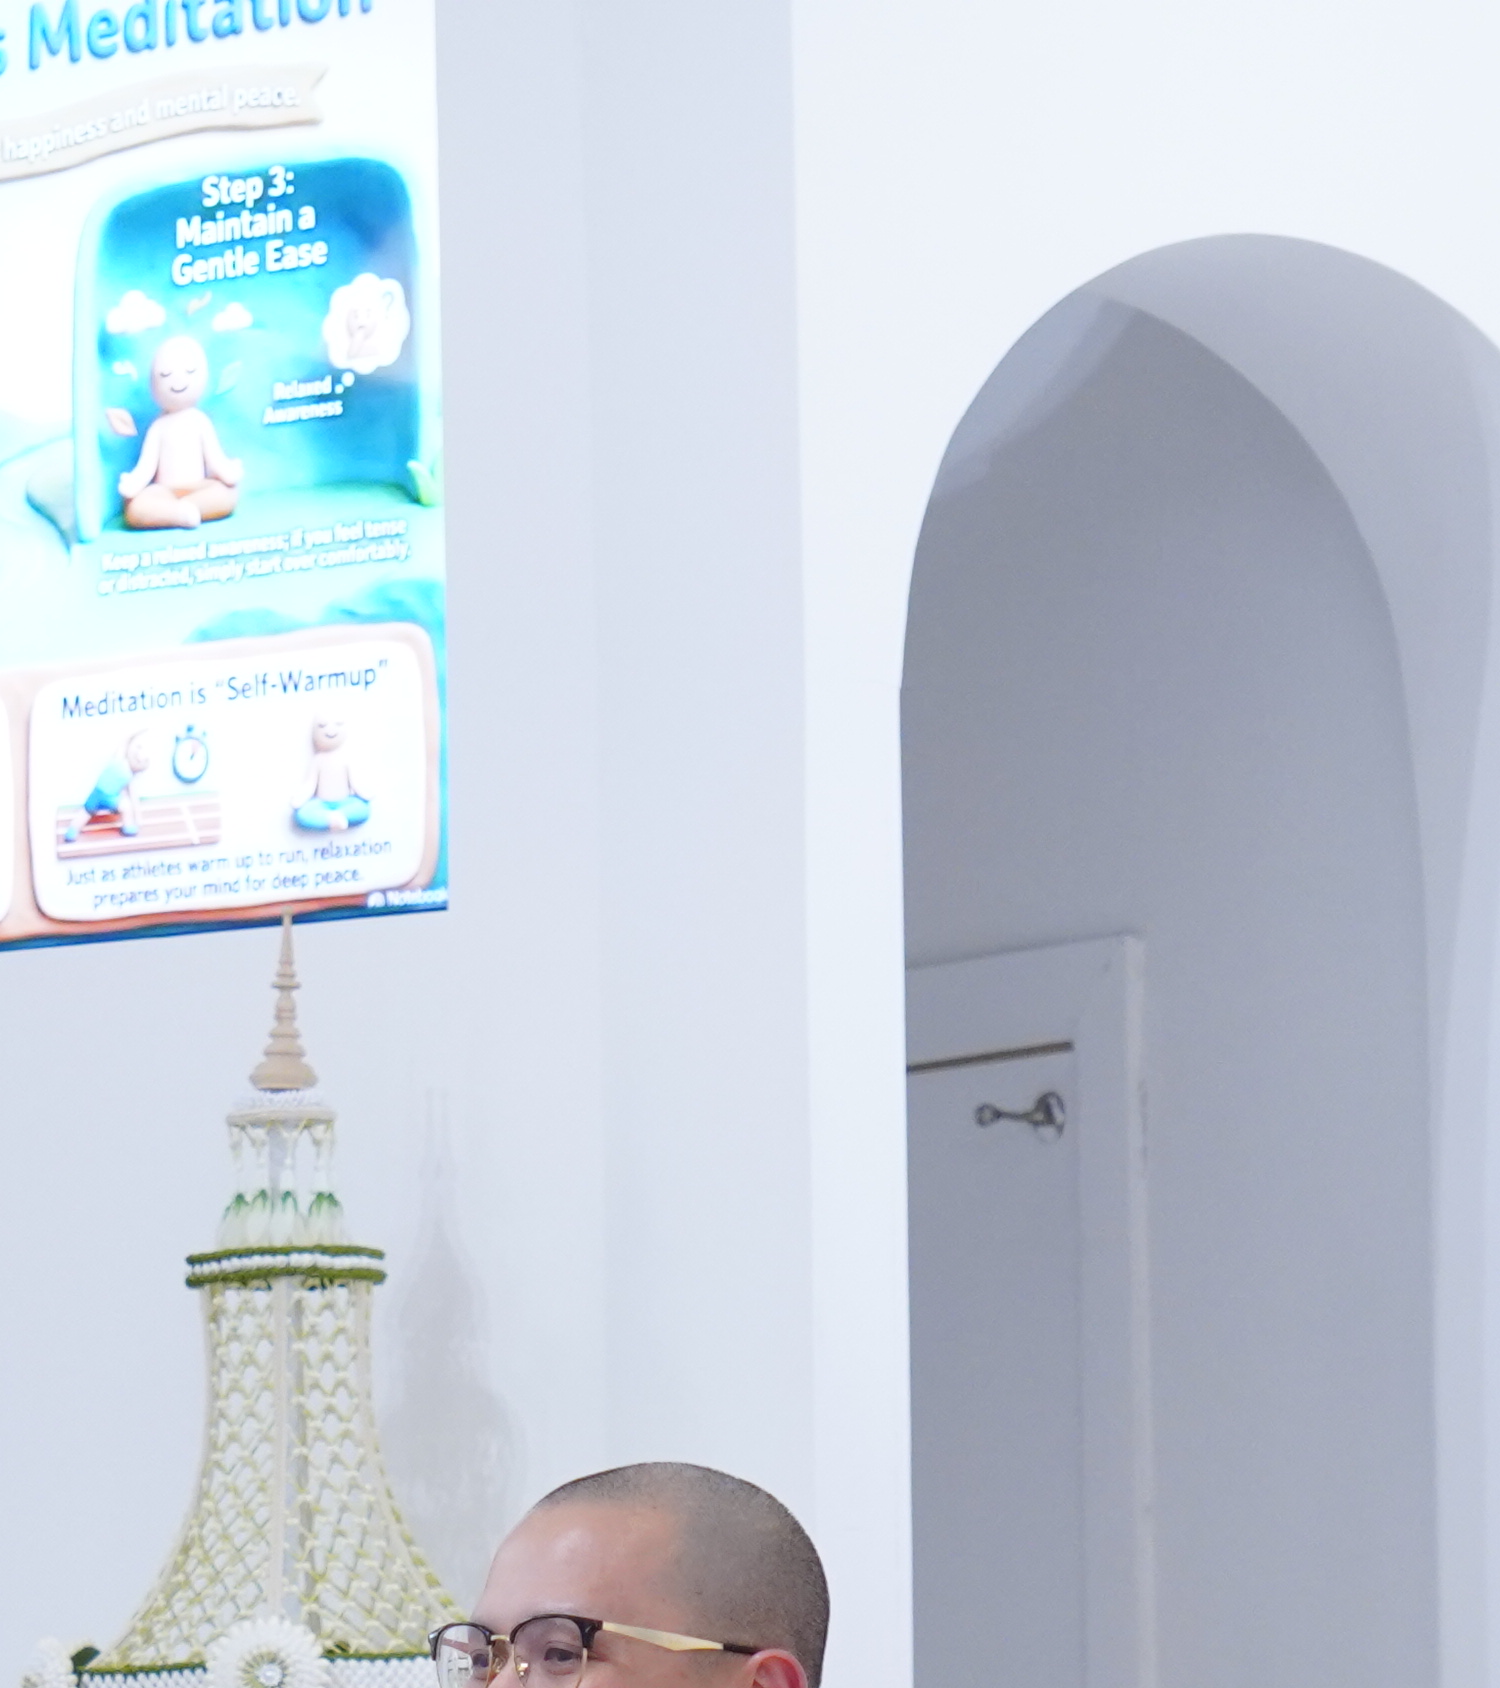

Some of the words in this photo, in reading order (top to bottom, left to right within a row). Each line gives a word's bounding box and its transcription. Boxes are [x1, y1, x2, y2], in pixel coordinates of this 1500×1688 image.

[3, 120, 109, 164] happiness
[110, 100, 151, 132] and
[156, 85, 228, 119] mental
[233, 85, 300, 116] peace.
[201, 174, 264, 208] Step
[267, 164, 295, 198] 3:
[174, 203, 294, 249] Maintain
[298, 206, 316, 231] a
[171, 245, 260, 287] Gentle
[264, 238, 329, 274] Ease
[272, 375, 332, 401] Relaxed
[262, 399, 344, 425] Awareness
[61, 688, 183, 720] Meditation
[189, 687, 207, 706] is
[215, 659, 388, 703] “Self-Warmup”
[67, 867, 96, 886] Just
[101, 866, 116, 881] as
[121, 859, 182, 879] athletes
[187, 856, 230, 873] warm
[236, 855, 254, 872] up
[259, 851, 273, 866] to
[313, 838, 392, 861] relaxation
[93, 889, 159, 911] prepares
[164, 884, 198, 902] your
[203, 878, 240, 896] mind
[244, 874, 267, 891] for
[271, 872, 309, 891] deep
